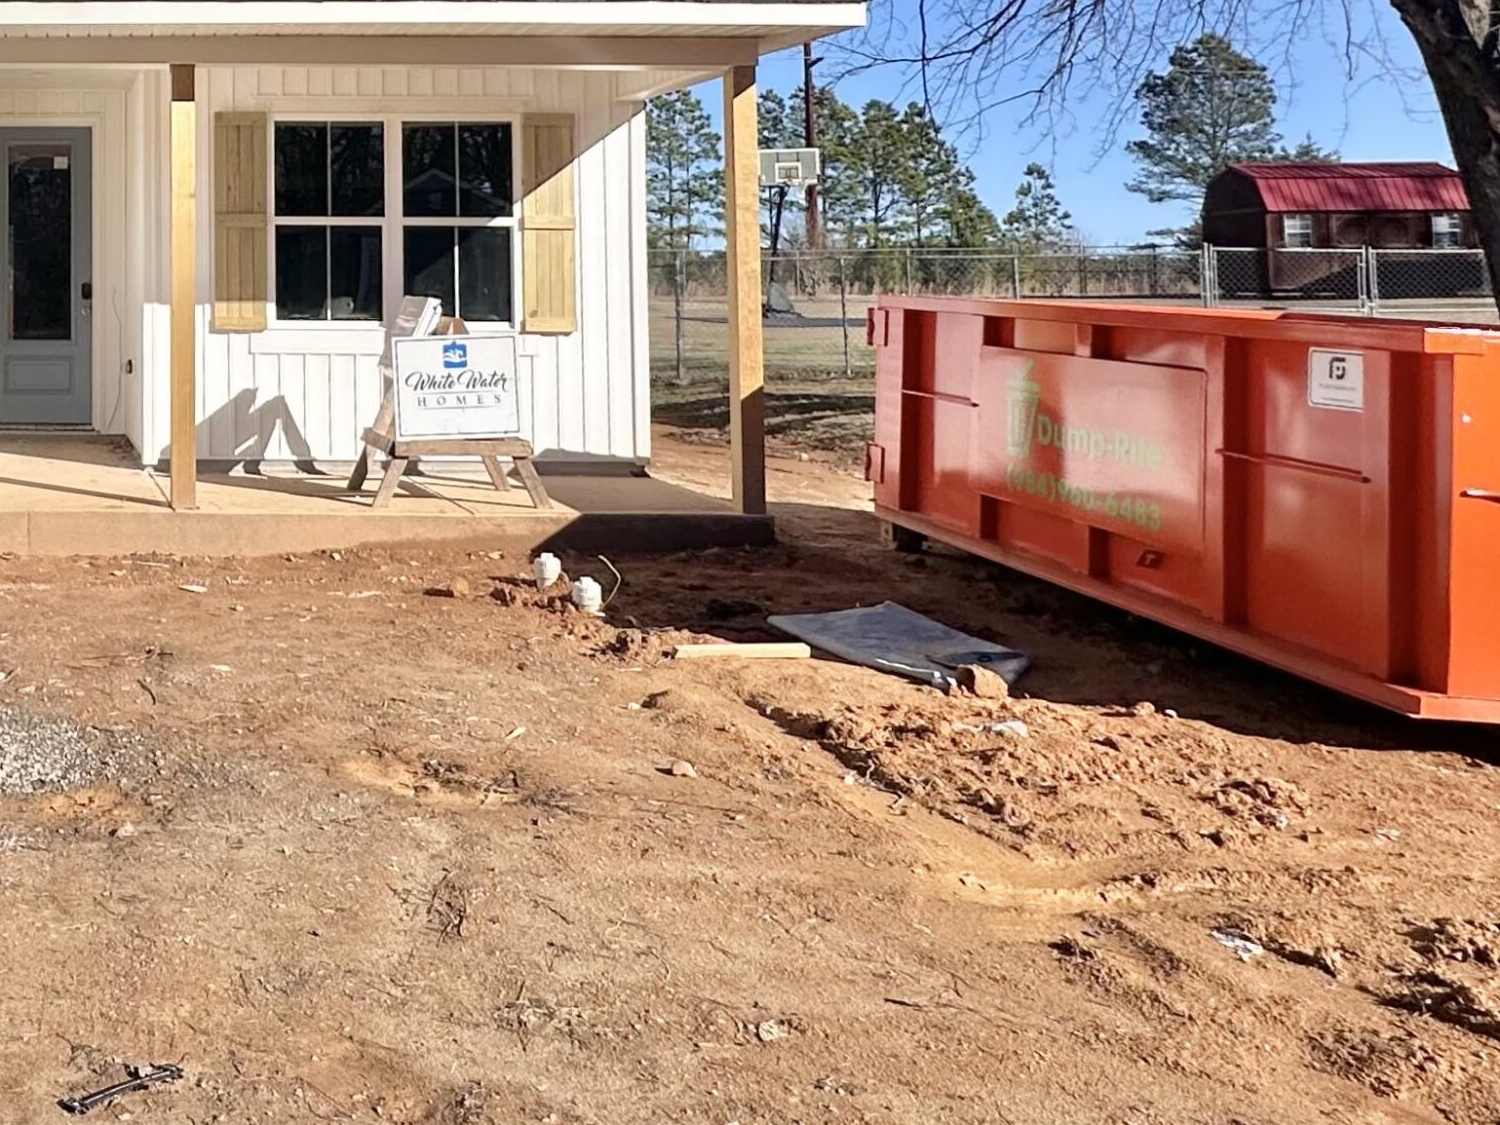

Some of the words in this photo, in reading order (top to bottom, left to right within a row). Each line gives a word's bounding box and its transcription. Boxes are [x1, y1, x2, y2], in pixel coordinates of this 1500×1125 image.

[405, 371, 455, 391] White
[457, 369, 508, 393] Water
[417, 394, 501, 407] HOMES
